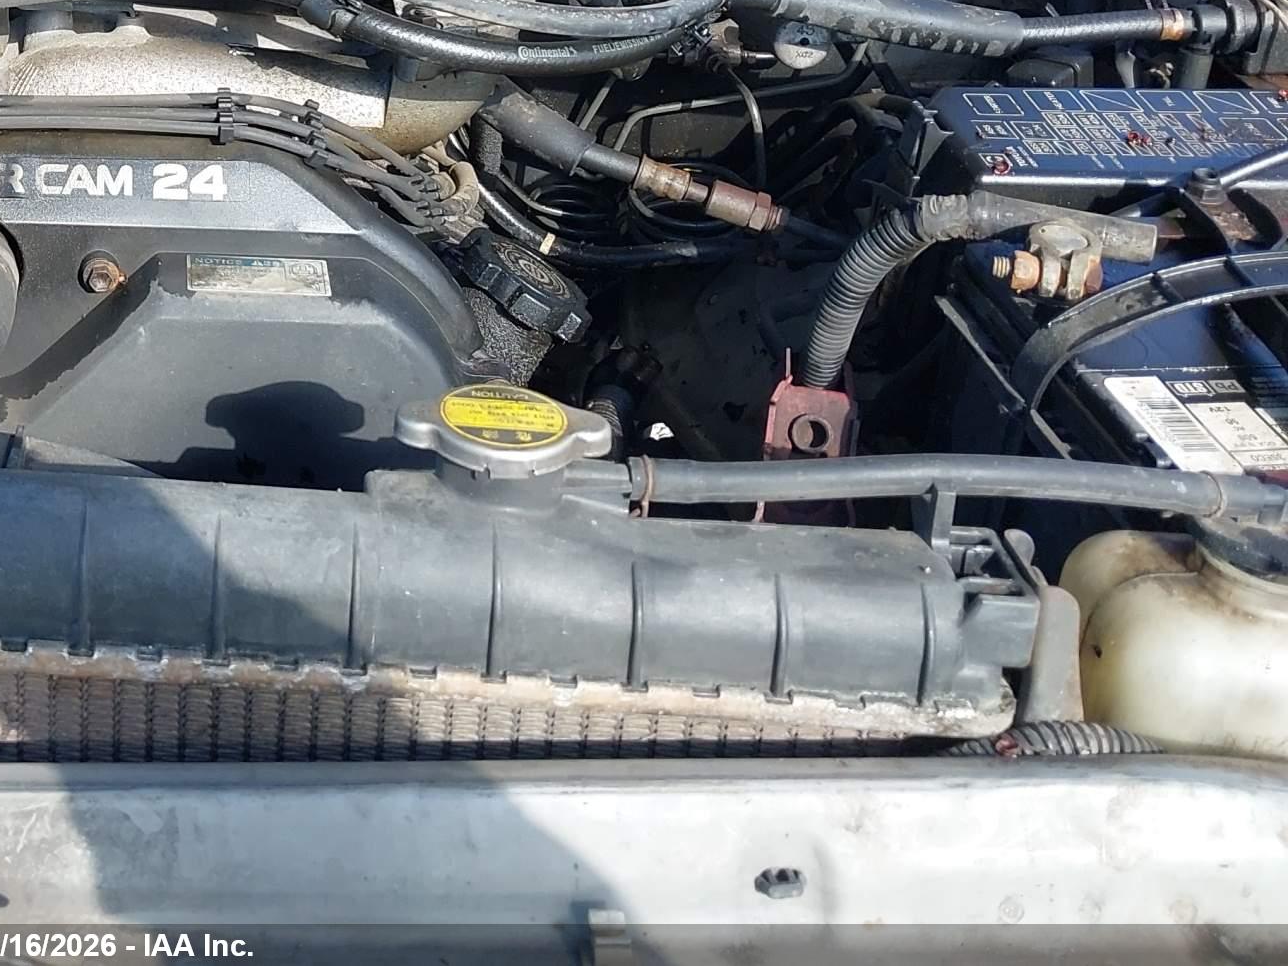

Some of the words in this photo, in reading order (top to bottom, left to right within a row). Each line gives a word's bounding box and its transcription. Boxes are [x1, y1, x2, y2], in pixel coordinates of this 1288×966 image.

[517, 45, 569, 60] Continental
[36, 163, 132, 196] CAM
[152, 164, 227, 200] 24
[1215, 382, 1240, 391] Pb
[471, 390, 529, 400] CAUTION
